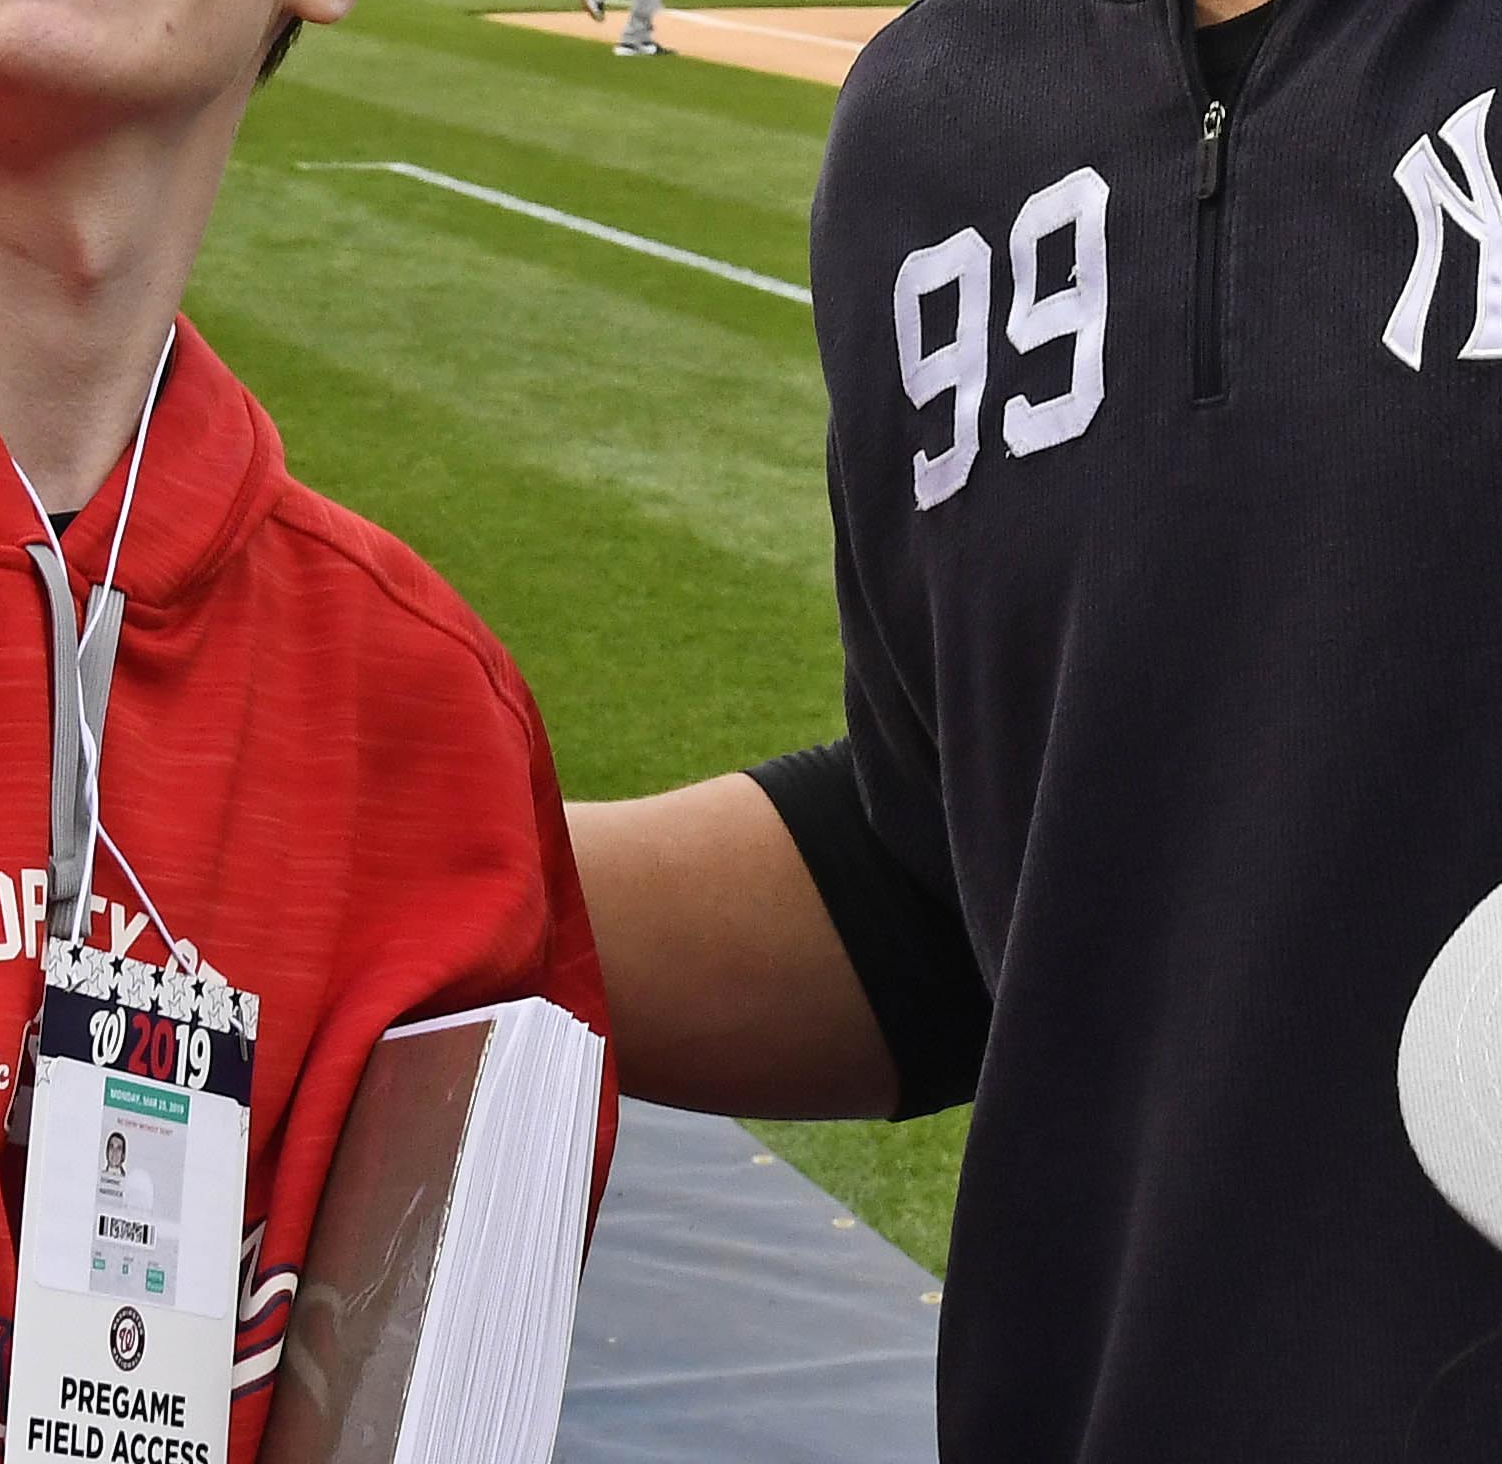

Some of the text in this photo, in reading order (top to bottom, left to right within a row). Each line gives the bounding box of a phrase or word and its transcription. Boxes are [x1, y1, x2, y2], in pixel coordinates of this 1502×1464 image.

[894, 165, 1110, 512] 99
[127, 1013, 211, 1090] 2019
[61, 1376, 186, 1428] PREGAME
[28, 1417, 209, 1464] FIELD ACCESS
